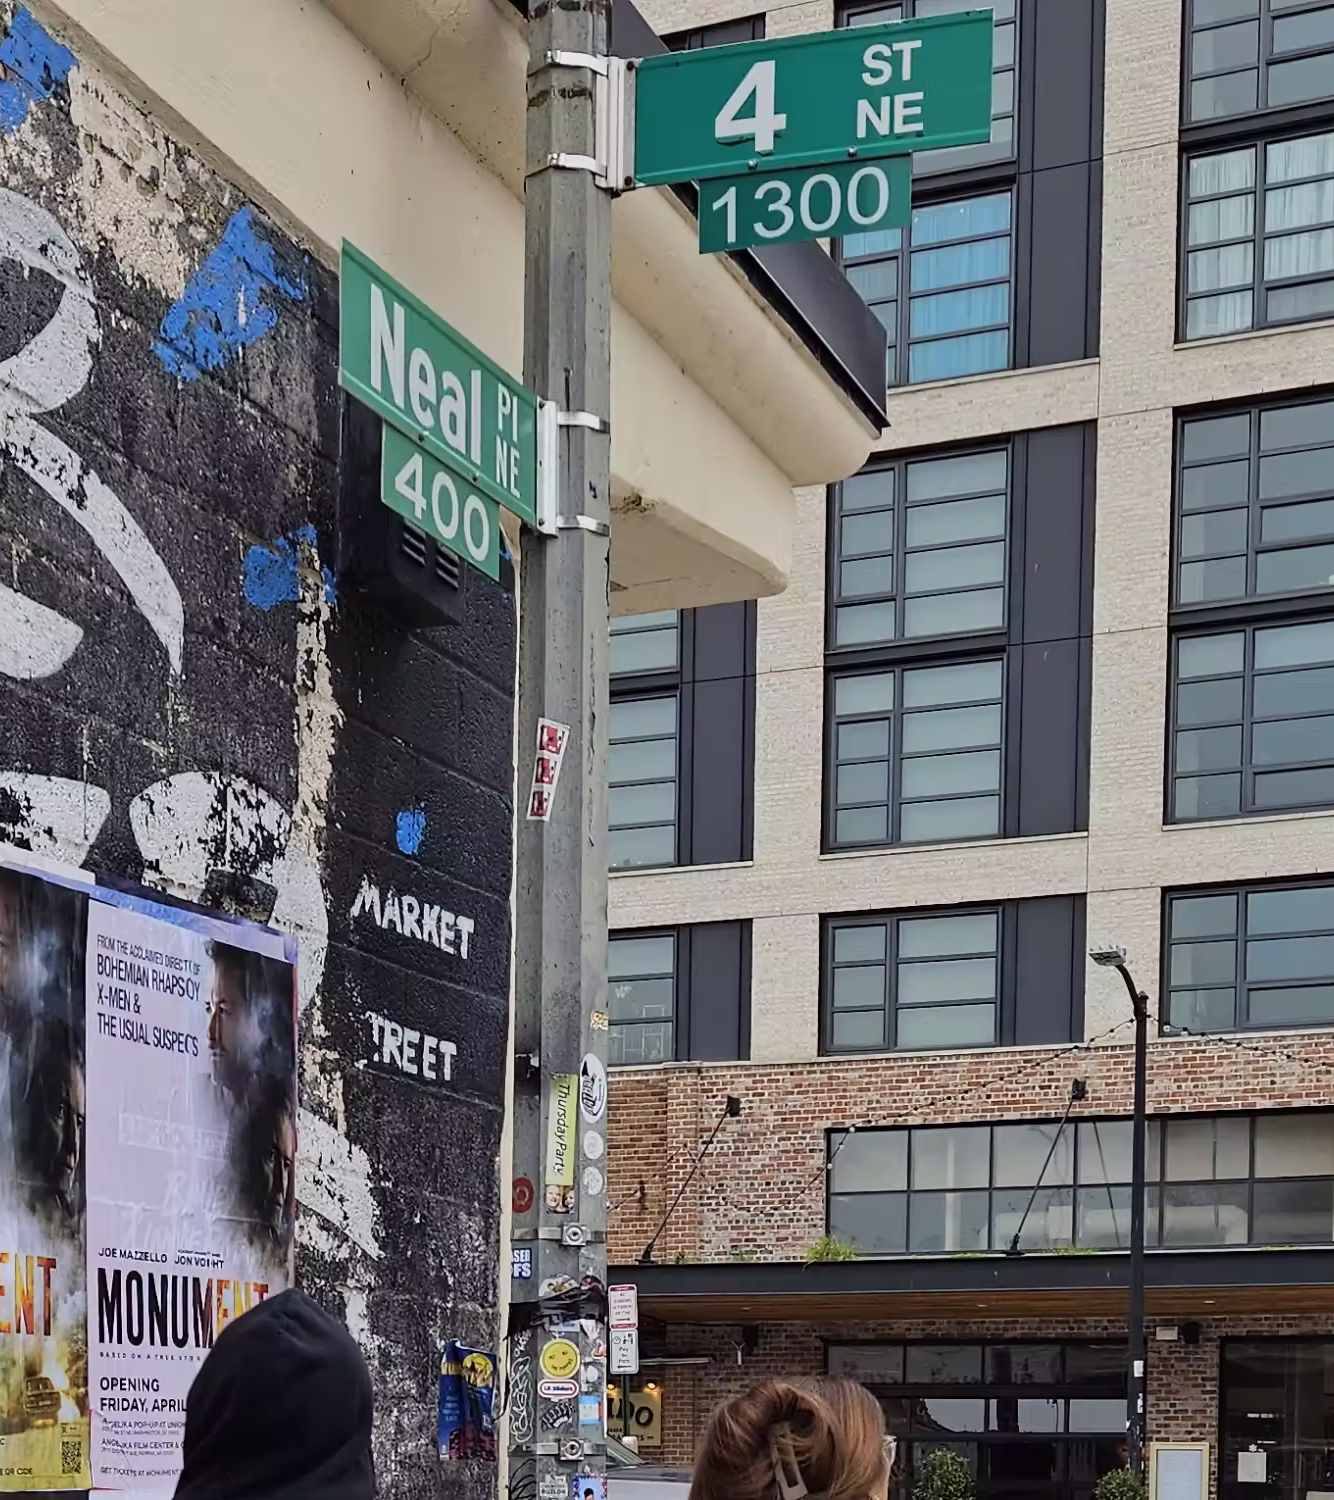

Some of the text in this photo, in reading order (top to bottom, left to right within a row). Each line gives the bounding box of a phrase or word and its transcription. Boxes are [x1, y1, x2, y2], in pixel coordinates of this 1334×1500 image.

[714, 39, 923, 152] 4 ST
[856, 91, 924, 138] NE
[712, 166, 890, 244] 1300
[370, 282, 482, 465] Neal
[394, 451, 491, 563] 400
[495, 438, 521, 500] NE
[351, 873, 475, 960] MARKET
[364, 1010, 457, 1082] TREET
[557, 1084, 571, 1140] Thursday
[513, 1249, 531, 1262] SER
[97, 1267, 269, 1352] MONUME
